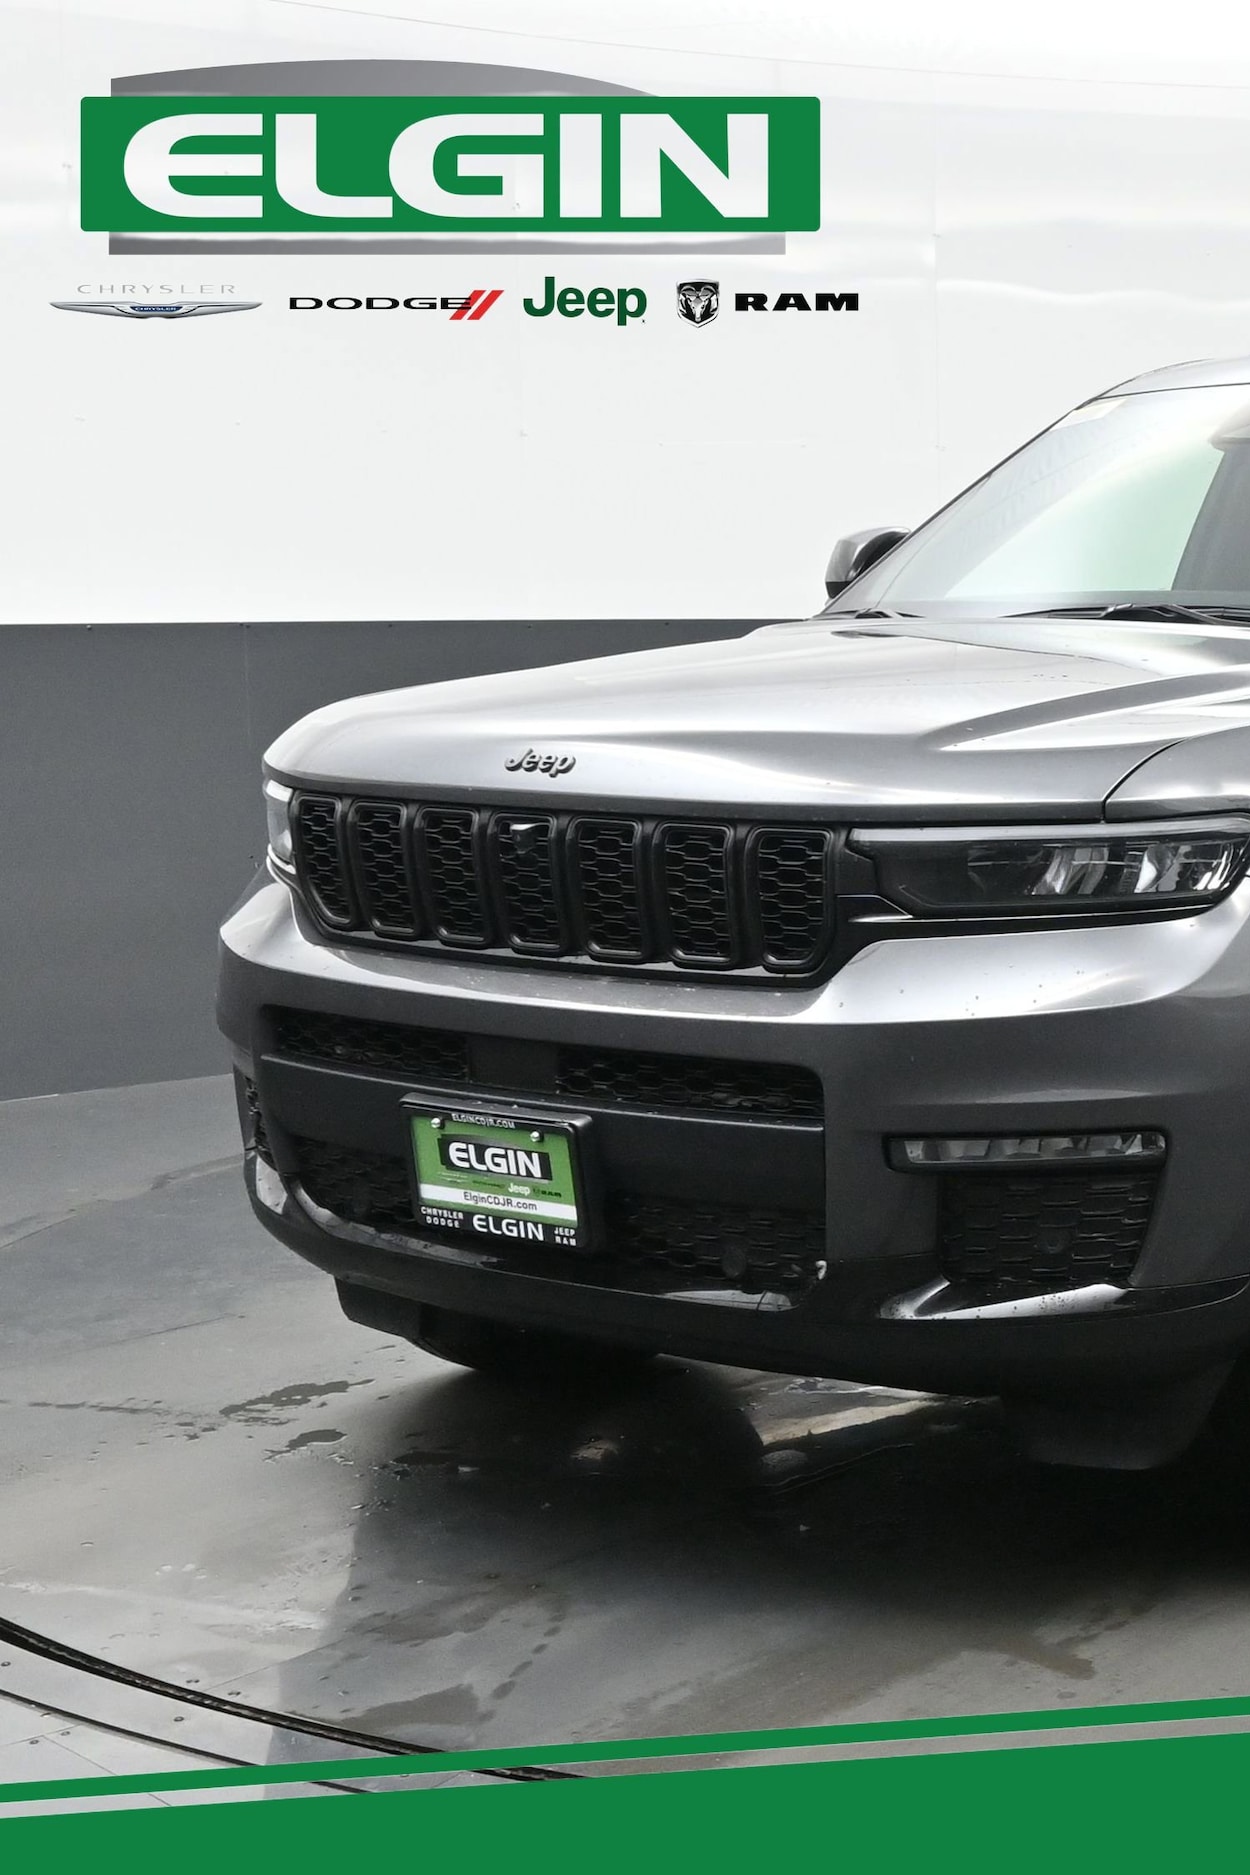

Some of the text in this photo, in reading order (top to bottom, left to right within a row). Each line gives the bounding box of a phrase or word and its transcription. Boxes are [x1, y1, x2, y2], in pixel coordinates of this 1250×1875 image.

[504, 748, 576, 778] Jeep
[448, 1141, 542, 1178] ELGIN
[507, 1182, 530, 1196] Jeep
[463, 1191, 537, 1211] ElginCDJR.com
[420, 1206, 464, 1220] CHRYSLER
[426, 1215, 460, 1228] DODGE
[472, 1214, 544, 1241] ELGIN
[554, 1226, 575, 1236] JEEP
[555, 1236, 576, 1246] RAM
